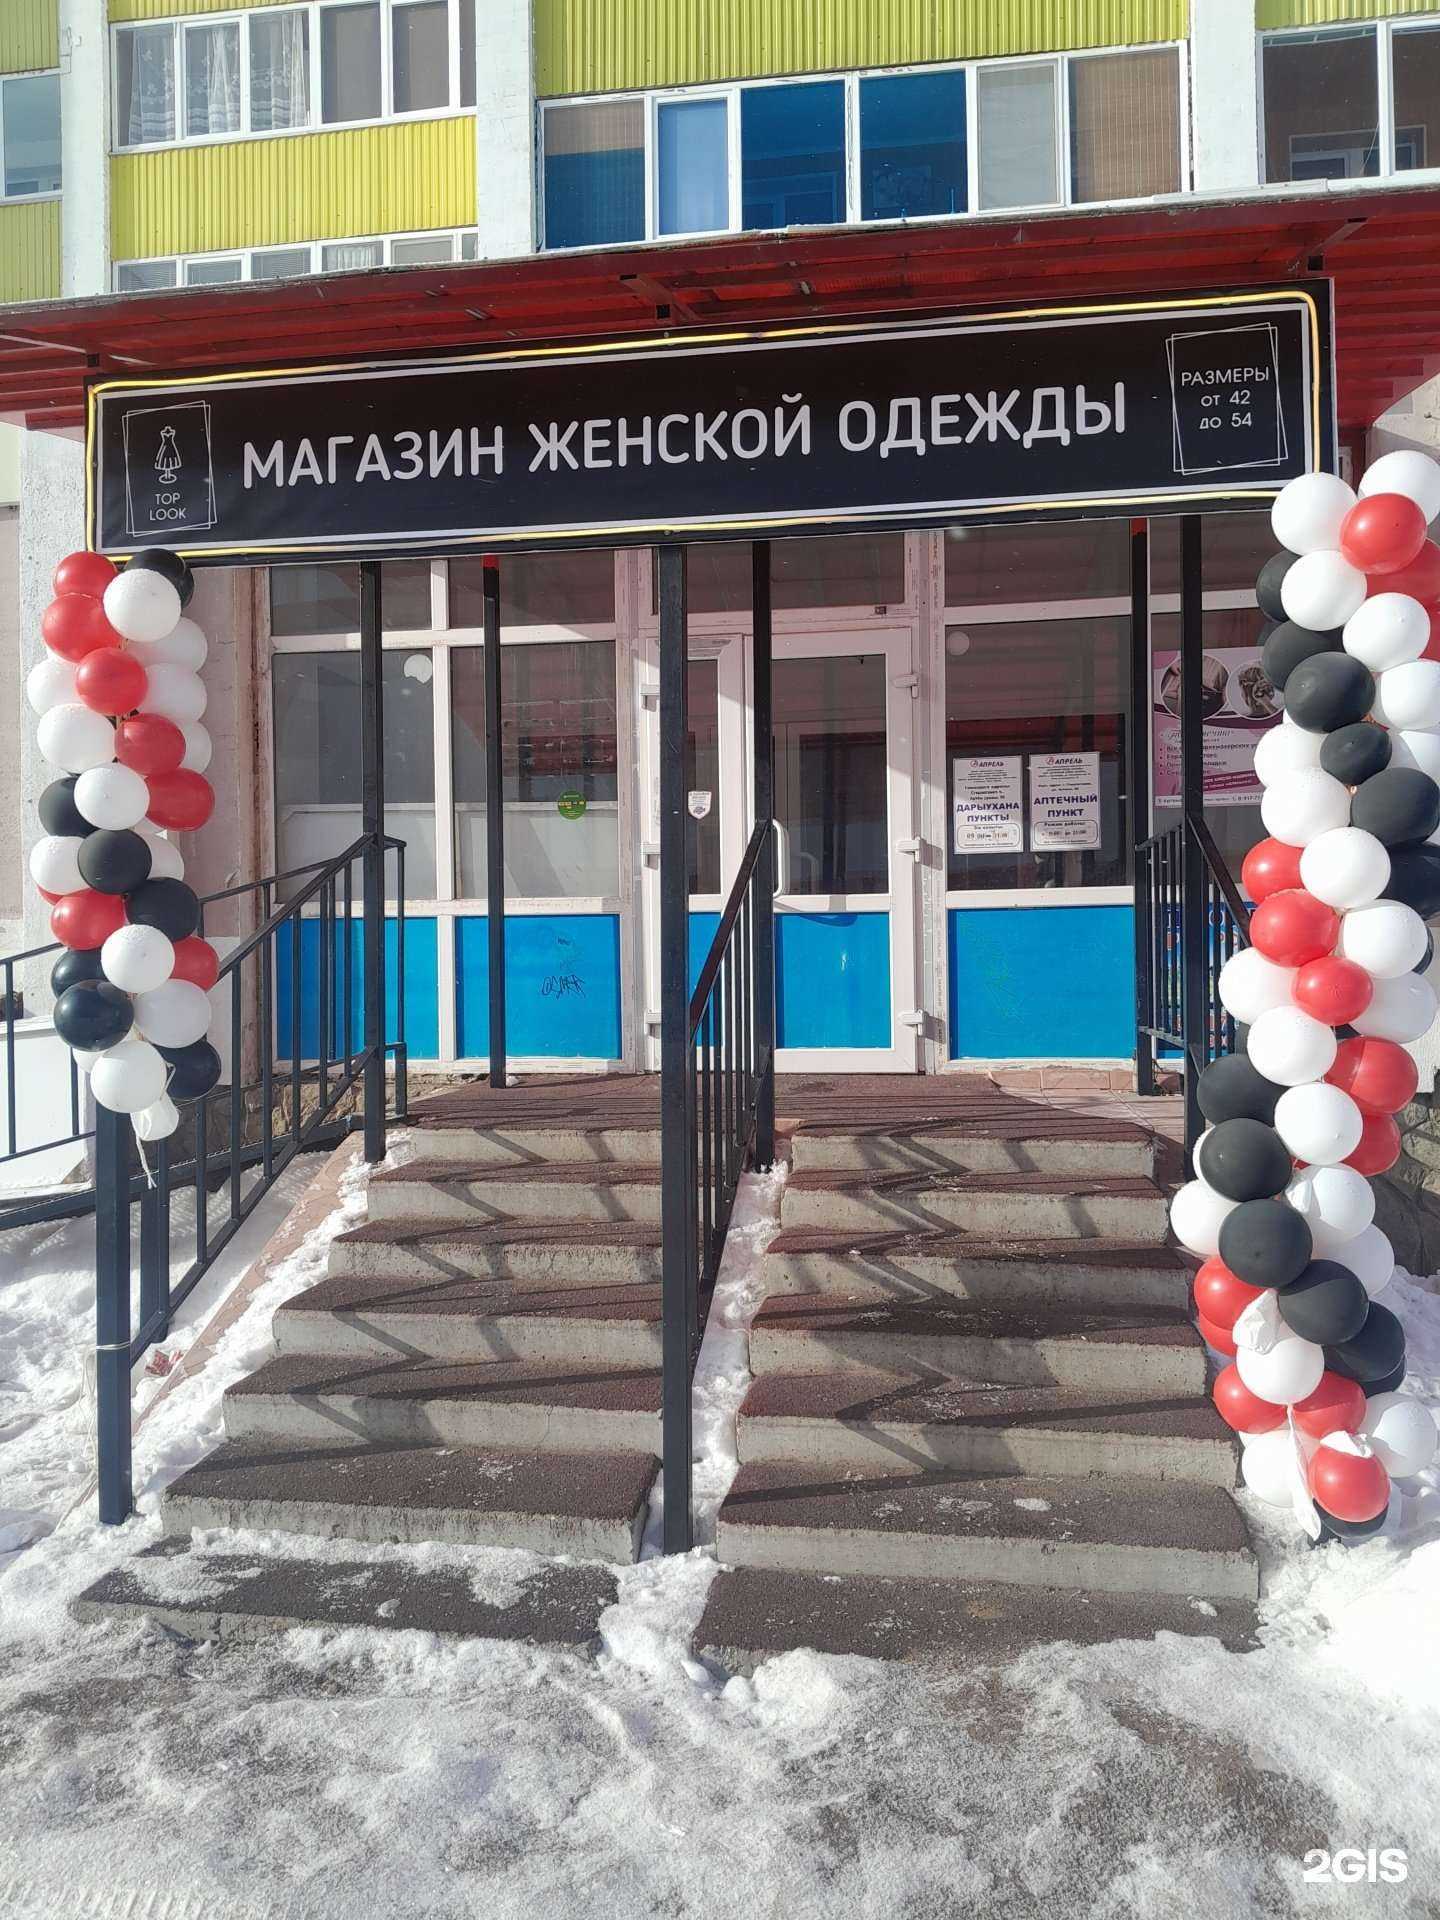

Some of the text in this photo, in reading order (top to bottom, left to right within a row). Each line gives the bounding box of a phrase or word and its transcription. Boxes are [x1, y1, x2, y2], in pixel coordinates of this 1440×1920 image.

[1181, 366, 1269, 387] РАЗМЕРЫ
[1229, 389, 1251, 405] 42
[1199, 411, 1252, 429] до 54
[242, 381, 1126, 489] МАГАЗИН ЖЕНСКОЙ ОДЕЖДЫ
[155, 492, 181, 505] TOP
[149, 507, 187, 521] LOOK
[979, 760, 1005, 768] АПРЕЛЬ
[1055, 758, 1083, 766] АПРЕЛЬ
[1033, 793, 1098, 805] АПТЕЧНЫЙ
[956, 801, 1020, 812] ДАРЫУХАНА
[967, 813, 1010, 822] ПУНКТЫ
[1047, 808, 1084, 818] ПУНКТ
